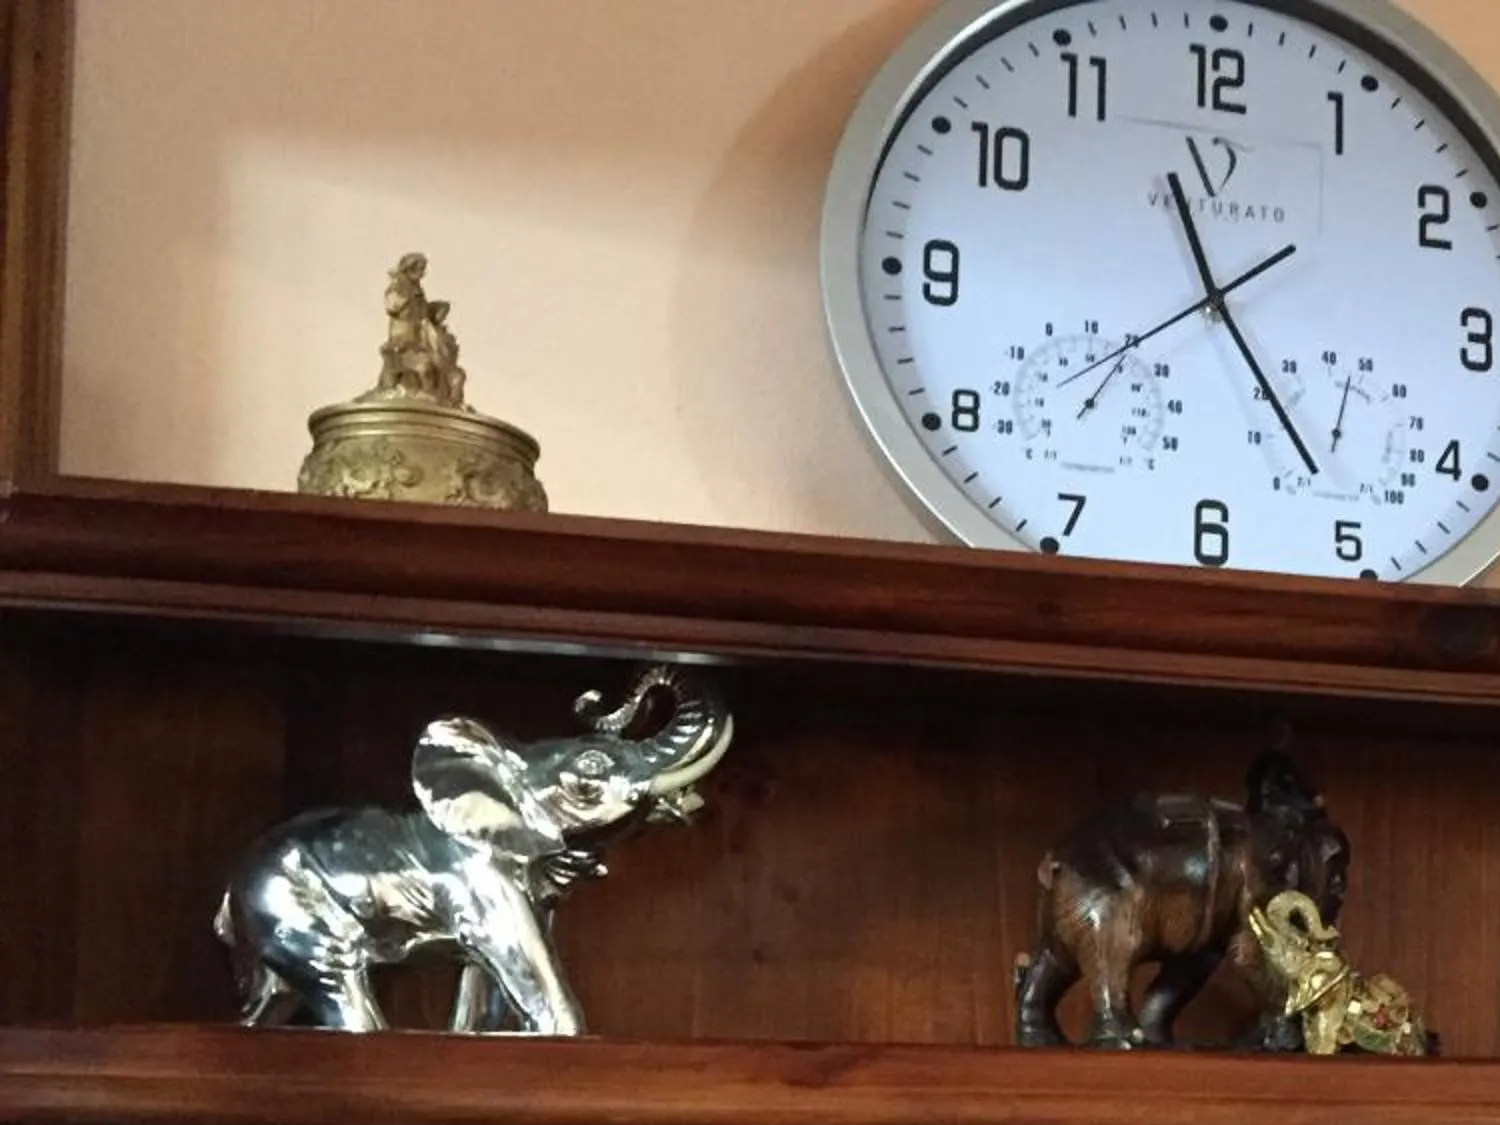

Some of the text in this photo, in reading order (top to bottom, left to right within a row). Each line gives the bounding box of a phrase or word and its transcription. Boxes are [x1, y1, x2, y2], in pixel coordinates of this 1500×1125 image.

[1060, 53, 1106, 122] 11
[1189, 44, 1246, 114] 12
[1328, 92, 1344, 155] 1
[971, 122, 1029, 191] 10
[1417, 185, 1452, 249] 2
[922, 240, 959, 306] 9
[1085, 320, 1098, 334] 10
[1322, 351, 1337, 365] 40
[1461, 307, 1493, 372] 3
[952, 389, 981, 432] 8
[1168, 400, 1183, 415] 40
[1435, 440, 1462, 481] 4
[1057, 494, 1086, 536] 7
[1194, 499, 1229, 568] 6
[1334, 521, 1362, 561] 5
